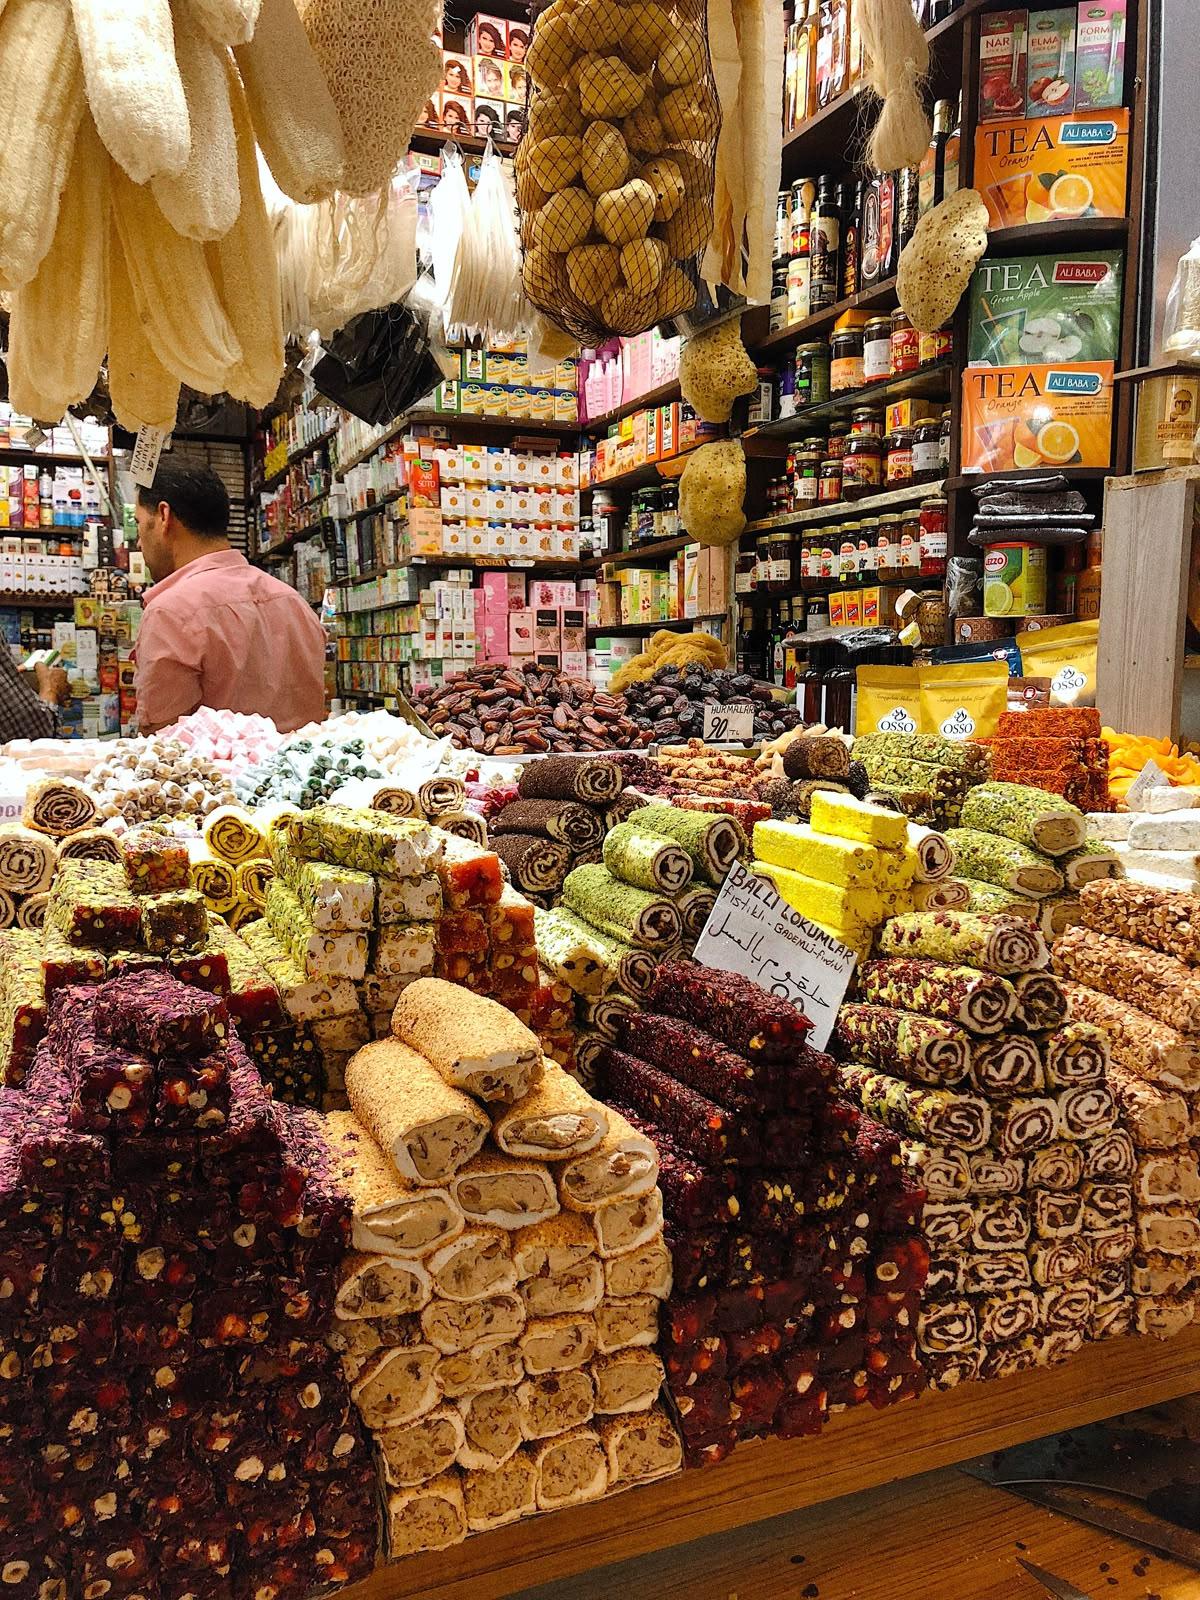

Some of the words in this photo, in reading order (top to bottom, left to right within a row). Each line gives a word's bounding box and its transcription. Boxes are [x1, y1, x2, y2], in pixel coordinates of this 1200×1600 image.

[1080, 25, 1111, 36] FORM
[985, 37, 1010, 49] NAR
[1031, 35, 1059, 47] ELMA
[1065, 128, 1081, 138] ALİ
[1081, 128, 1103, 138] BABA
[984, 124, 1055, 157] TEA
[999, 153, 1035, 169] Orange
[978, 263, 1050, 293] TEA
[1059, 267, 1075, 278] ALİ
[1075, 268, 1097, 278] BABA
[990, 293, 1015, 308] Green
[1017, 288, 1041, 303] Apple
[972, 371, 1042, 399] TEA
[1052, 378, 1066, 388] ALİ
[1067, 378, 1089, 389] BABA
[987, 398, 1022, 413] Orange
[1051, 676, 1084, 692] OSSO
[710, 703, 755, 714] HURMALAR
[706, 716, 728, 739] 90
[880, 720, 914, 733] OSSO
[943, 723, 973, 735] OSSO
[729, 865, 781, 909] BALLI
[781, 904, 855, 966] LOKUMLAR
